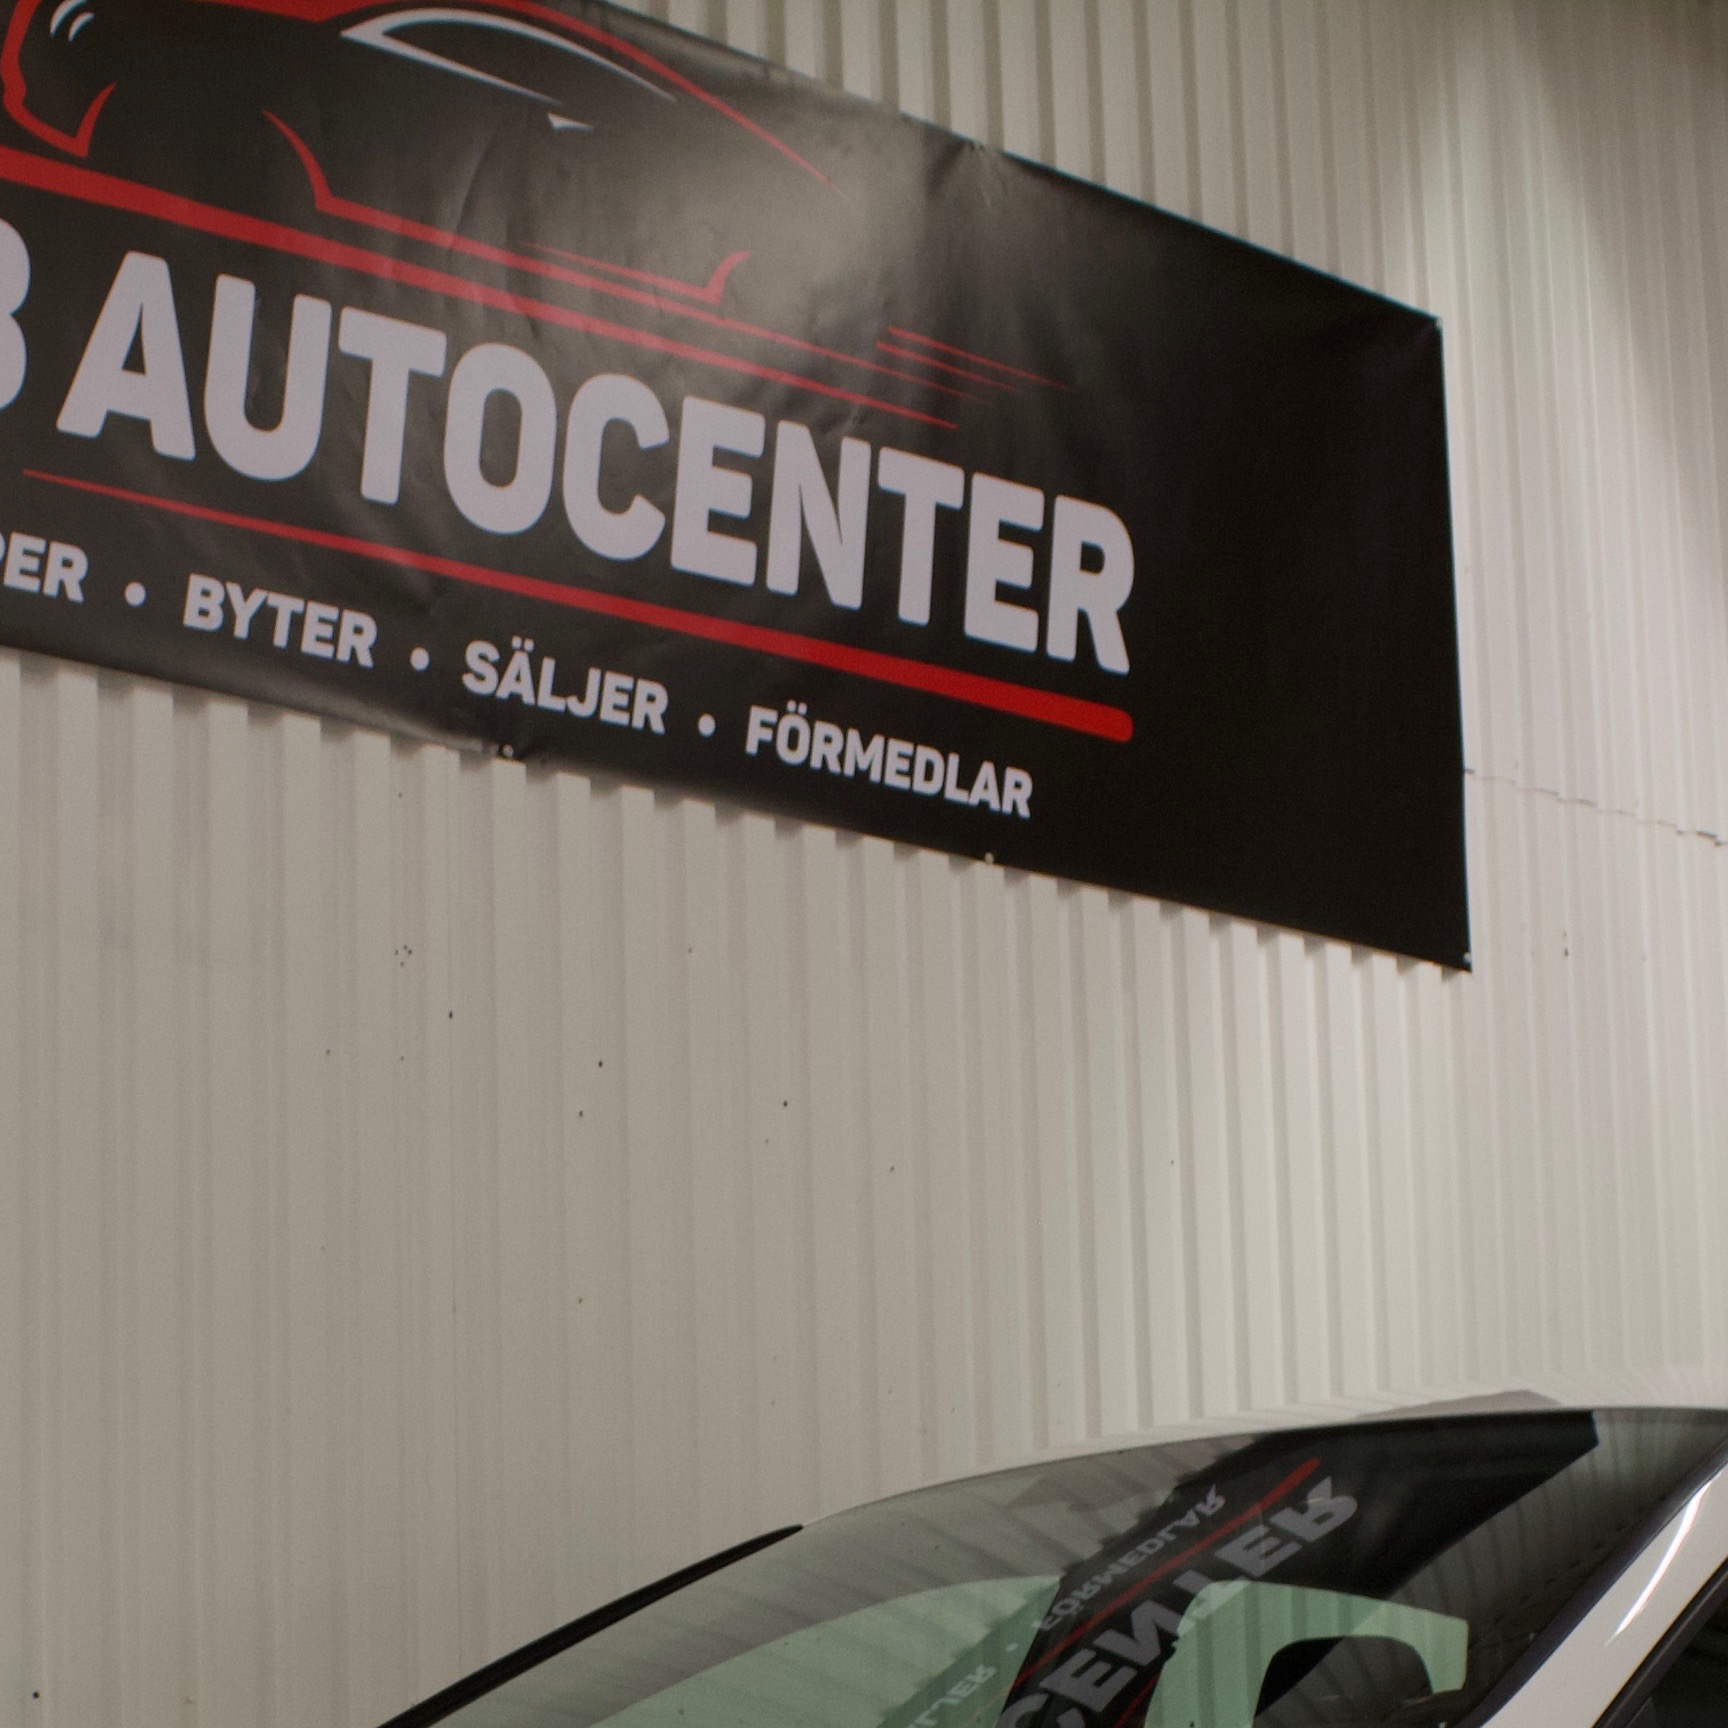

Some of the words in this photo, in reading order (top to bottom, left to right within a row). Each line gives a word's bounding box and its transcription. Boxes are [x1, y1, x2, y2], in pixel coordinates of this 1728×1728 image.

[56, 251, 1135, 674] AUTOCENTER
[182, 573, 378, 668] BYTER
[461, 639, 670, 734] SÄLJER
[744, 704, 1034, 819] FÖRMEDLAR
